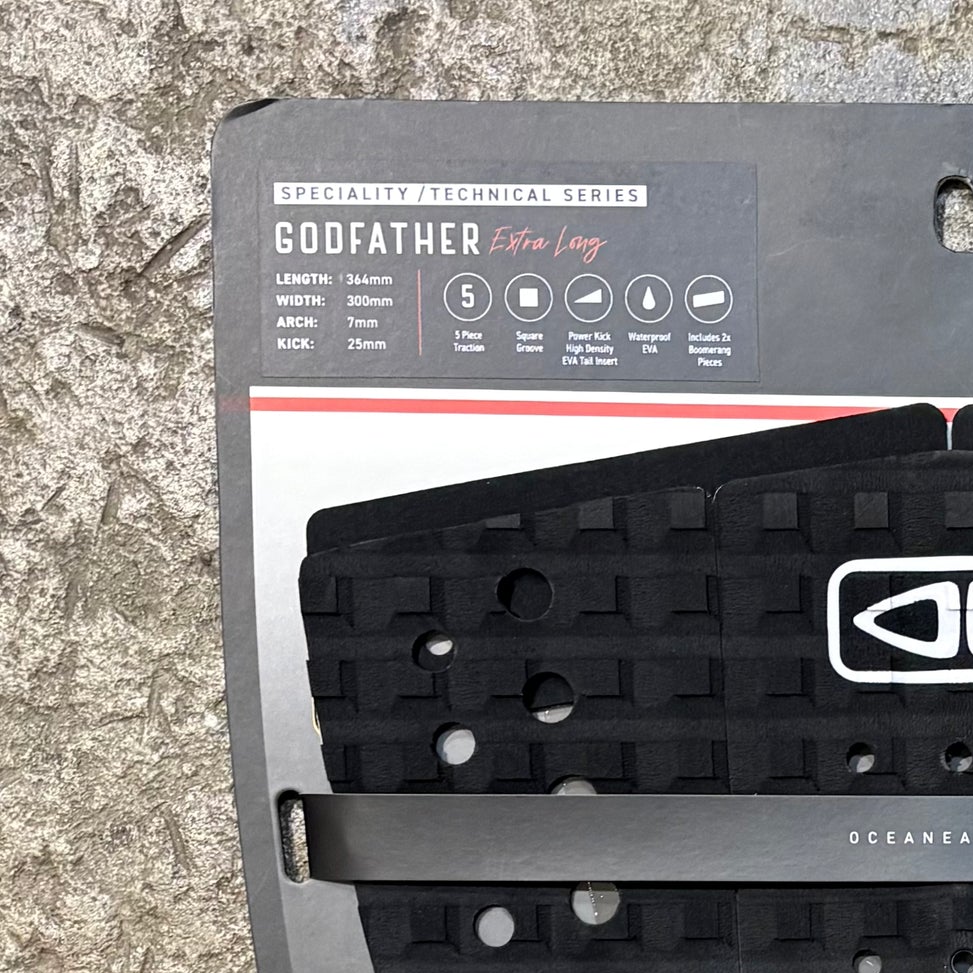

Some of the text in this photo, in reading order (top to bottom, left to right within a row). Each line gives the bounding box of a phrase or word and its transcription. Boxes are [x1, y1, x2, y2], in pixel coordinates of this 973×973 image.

[281, 186, 408, 201] SPECIALITY
[564, 188, 639, 202] SERIES
[275, 221, 607, 264] GODFATHER Extra Long
[276, 273, 393, 285] LENGTH: 364mm
[276, 294, 393, 307] WIDTH: 300mm
[461, 284, 475, 308] 5
[276, 316, 378, 328] ARCH: 7mm
[454, 330, 483, 340] 5 Piece
[516, 330, 544, 342] Square
[568, 331, 611, 341] Power Kick
[628, 332, 672, 343] Waterproof
[688, 332, 731, 342] Includes 2x
[277, 337, 387, 350] KICK: 25mm
[453, 343, 485, 352] Traction
[516, 343, 544, 353] Groove
[566, 344, 614, 355] High Density
[642, 345, 658, 354] EVA
[688, 345, 732, 356] Boomerang
[562, 356, 618, 366] EVA Tail Insert
[697, 357, 723, 367] Pieces
